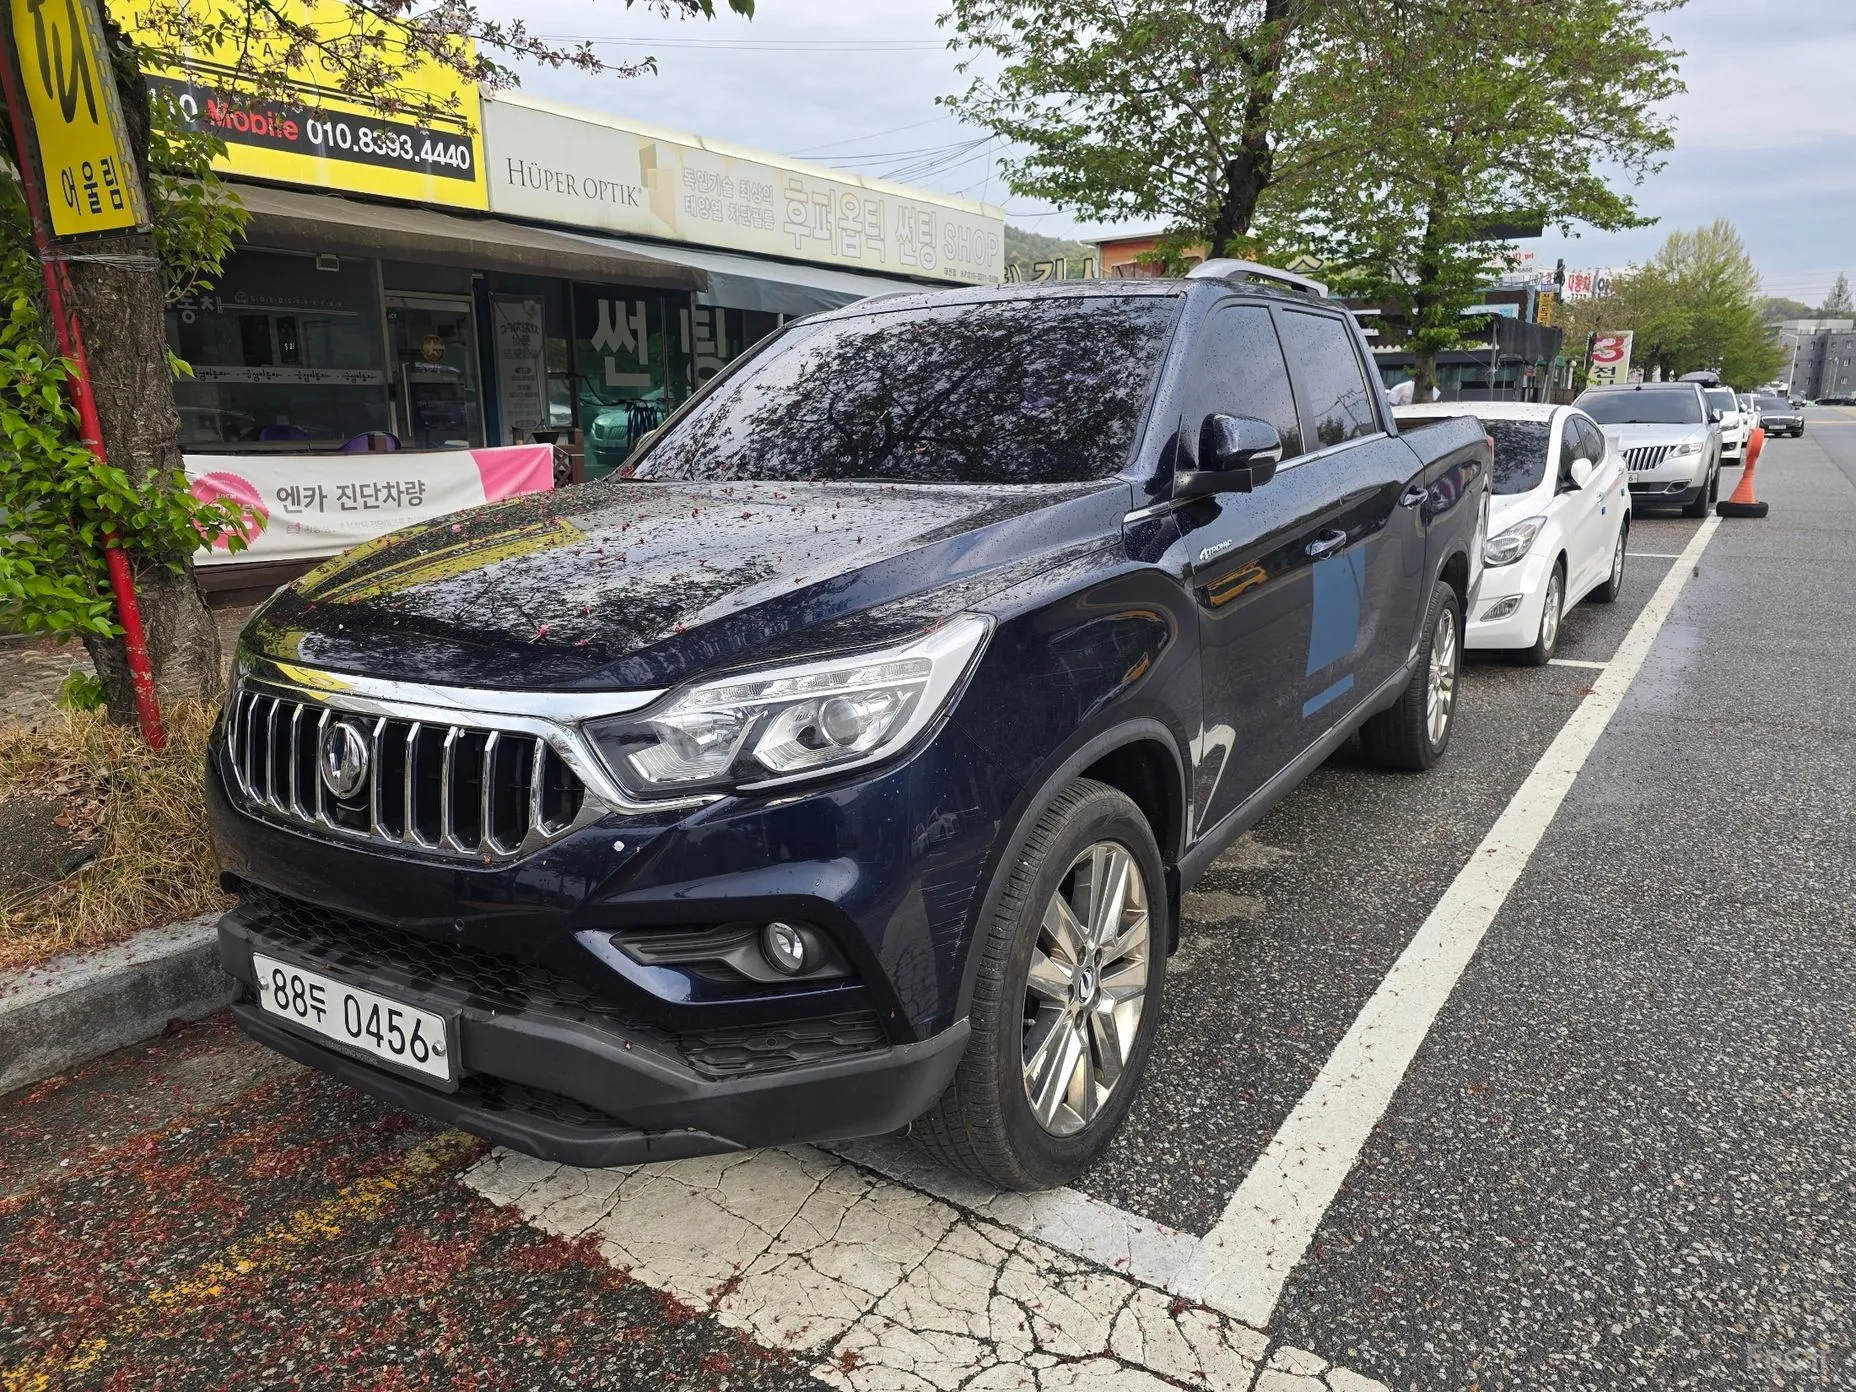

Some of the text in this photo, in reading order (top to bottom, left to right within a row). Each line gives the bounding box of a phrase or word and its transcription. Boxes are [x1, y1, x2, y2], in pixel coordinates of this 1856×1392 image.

[207, 98, 299, 141] Mobile
[306, 118, 470, 170] 010.8393.4440
[61, 155, 124, 216] 어울림
[506, 157, 579, 196] HÜPER
[683, 167, 774, 206] 독일기술 최상의
[684, 194, 775, 231] 태양열 차단필름
[783, 177, 999, 271] 후퍼옵틱 썬팅 SHOP
[276, 484, 328, 515] 엔카
[336, 479, 426, 512] 진단차량
[271, 968, 429, 1063] 88두 0456
